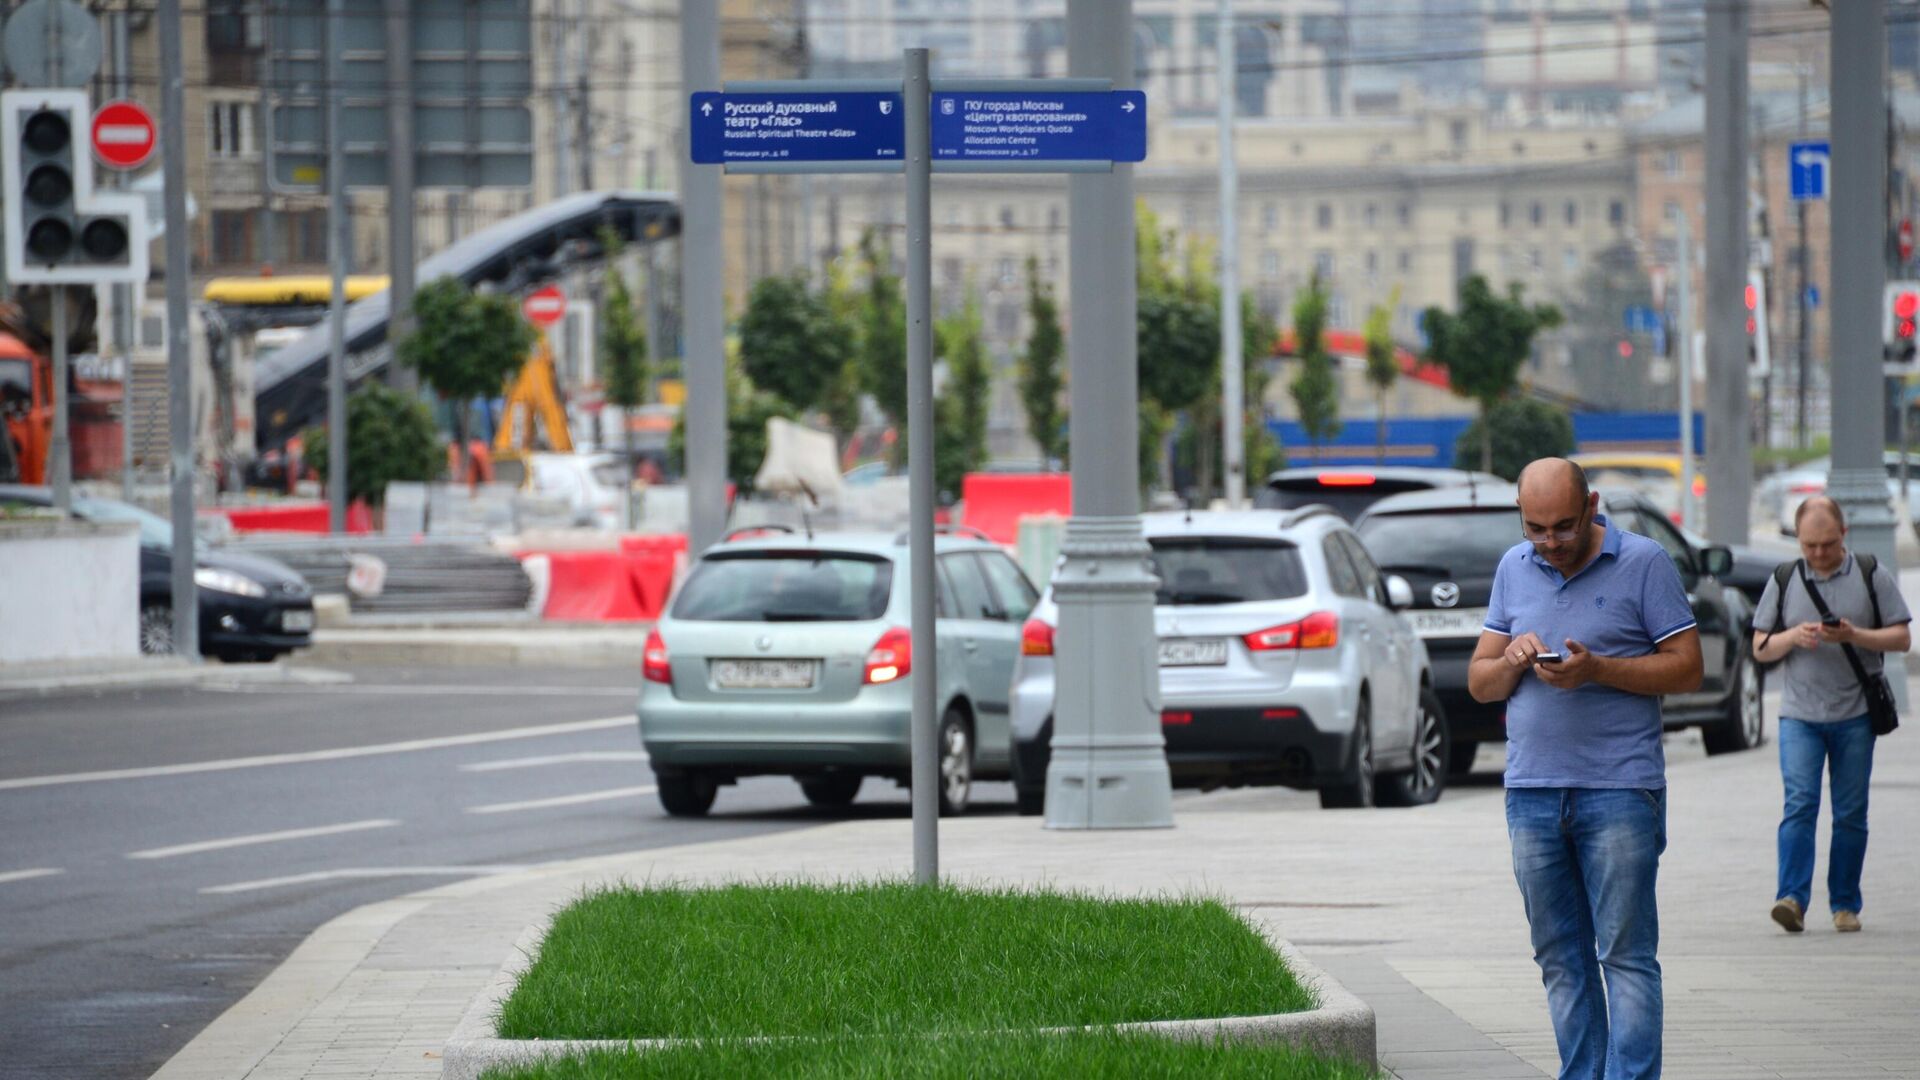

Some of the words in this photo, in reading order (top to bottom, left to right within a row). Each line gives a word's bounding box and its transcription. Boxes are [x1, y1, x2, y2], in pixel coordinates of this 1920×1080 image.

[724, 101, 774, 116] Русский
[775, 101, 837, 116] духовный
[964, 101, 983, 110] ГКУ
[984, 102, 1020, 112] города
[1022, 101, 1064, 111] Москвы
[724, 117, 759, 129] театр
[761, 115, 802, 126] «Глас»
[964, 113, 1004, 123] «Центр
[1005, 114, 1087, 124] квотирования»
[724, 130, 757, 138] Russian
[757, 130, 794, 139] Spiritual
[795, 130, 827, 138] Theatre
[828, 129, 857, 138] «Glas»
[964, 125, 998, 133] Moscow
[998, 125, 1046, 134] Workplaces
[1047, 125, 1073, 134] Quota
[1007, 136, 1037, 145] Centre
